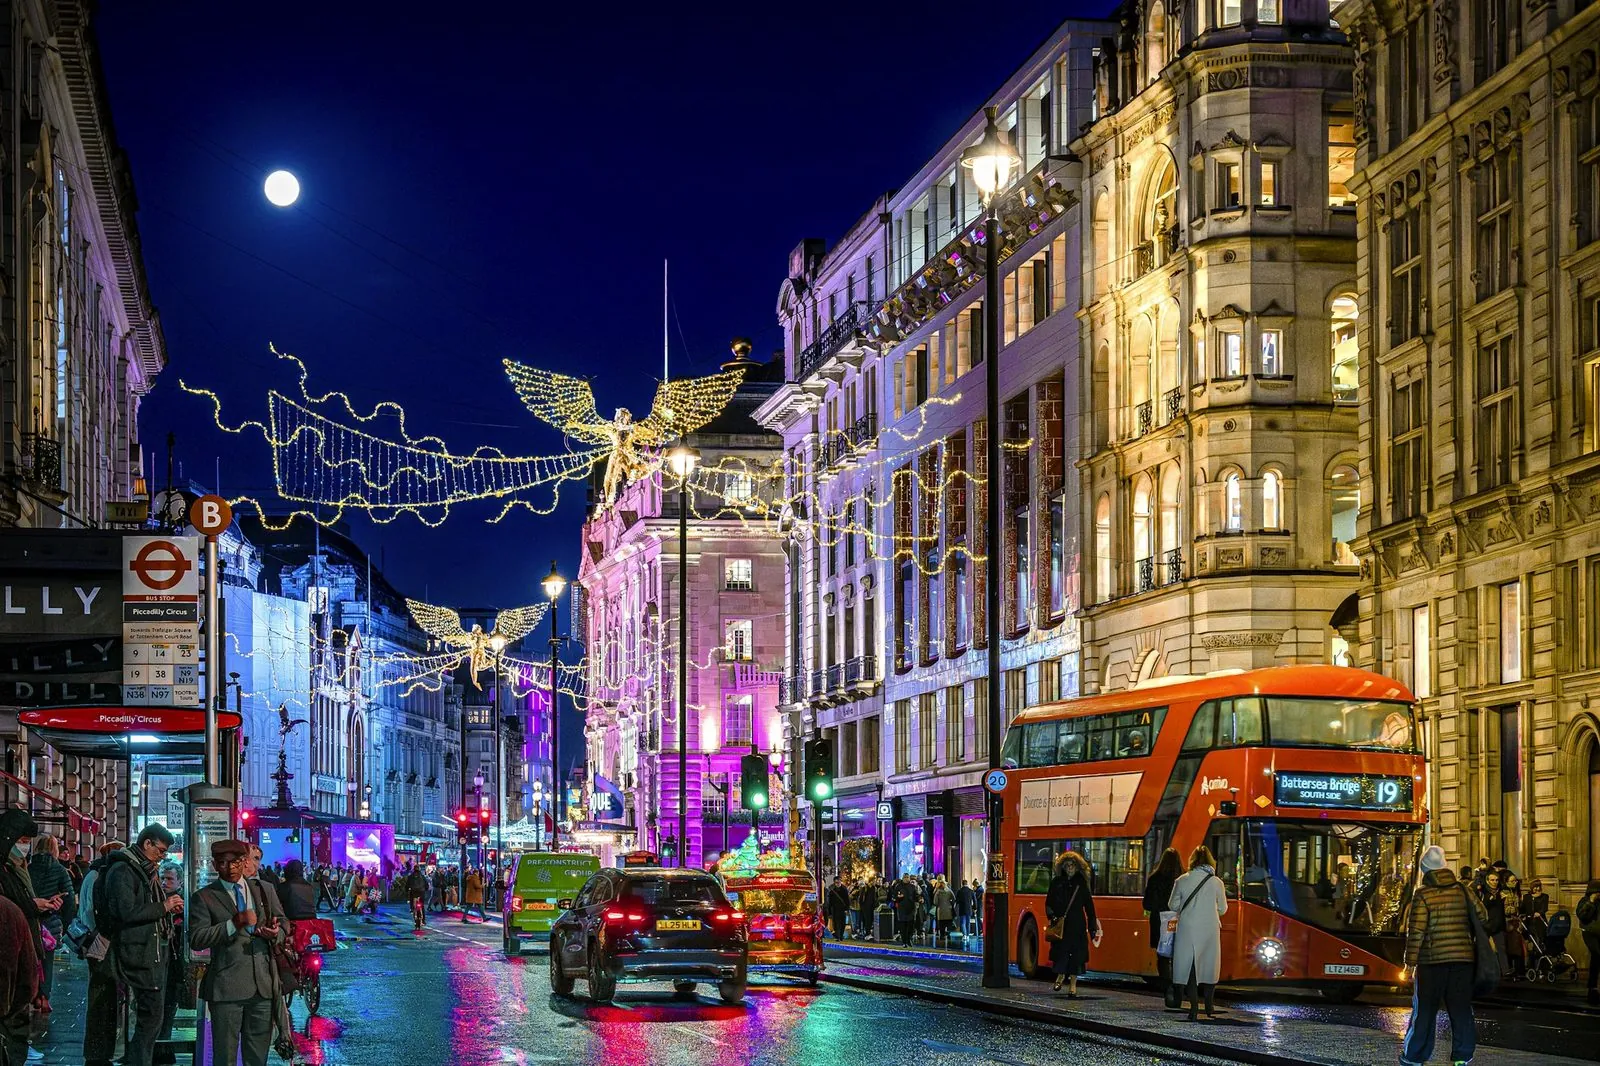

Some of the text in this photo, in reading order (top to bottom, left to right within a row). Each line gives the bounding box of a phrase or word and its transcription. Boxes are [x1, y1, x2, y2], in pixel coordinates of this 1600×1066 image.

[115, 507, 137, 517] TAXI
[202, 501, 222, 528] B
[132, 608, 165, 616] Piccadilly
[132, 649, 139, 658] 9
[155, 649, 165, 657] 14
[181, 649, 192, 658] 23
[130, 670, 140, 678] 19
[155, 670, 166, 678] 38
[15, 681, 123, 700] DILL
[126, 691, 145, 699] N38
[151, 691, 170, 699] N97
[100, 715, 162, 724] Piccadilly Circus
[989, 775, 1006, 786] 20
[1281, 775, 1398, 803] Battersea Bridge 19
[1299, 790, 1342, 800] SOUTH SIDE
[527, 859, 593, 867] PRE-CONSTRUCT
[564, 869, 593, 877] GROUP
